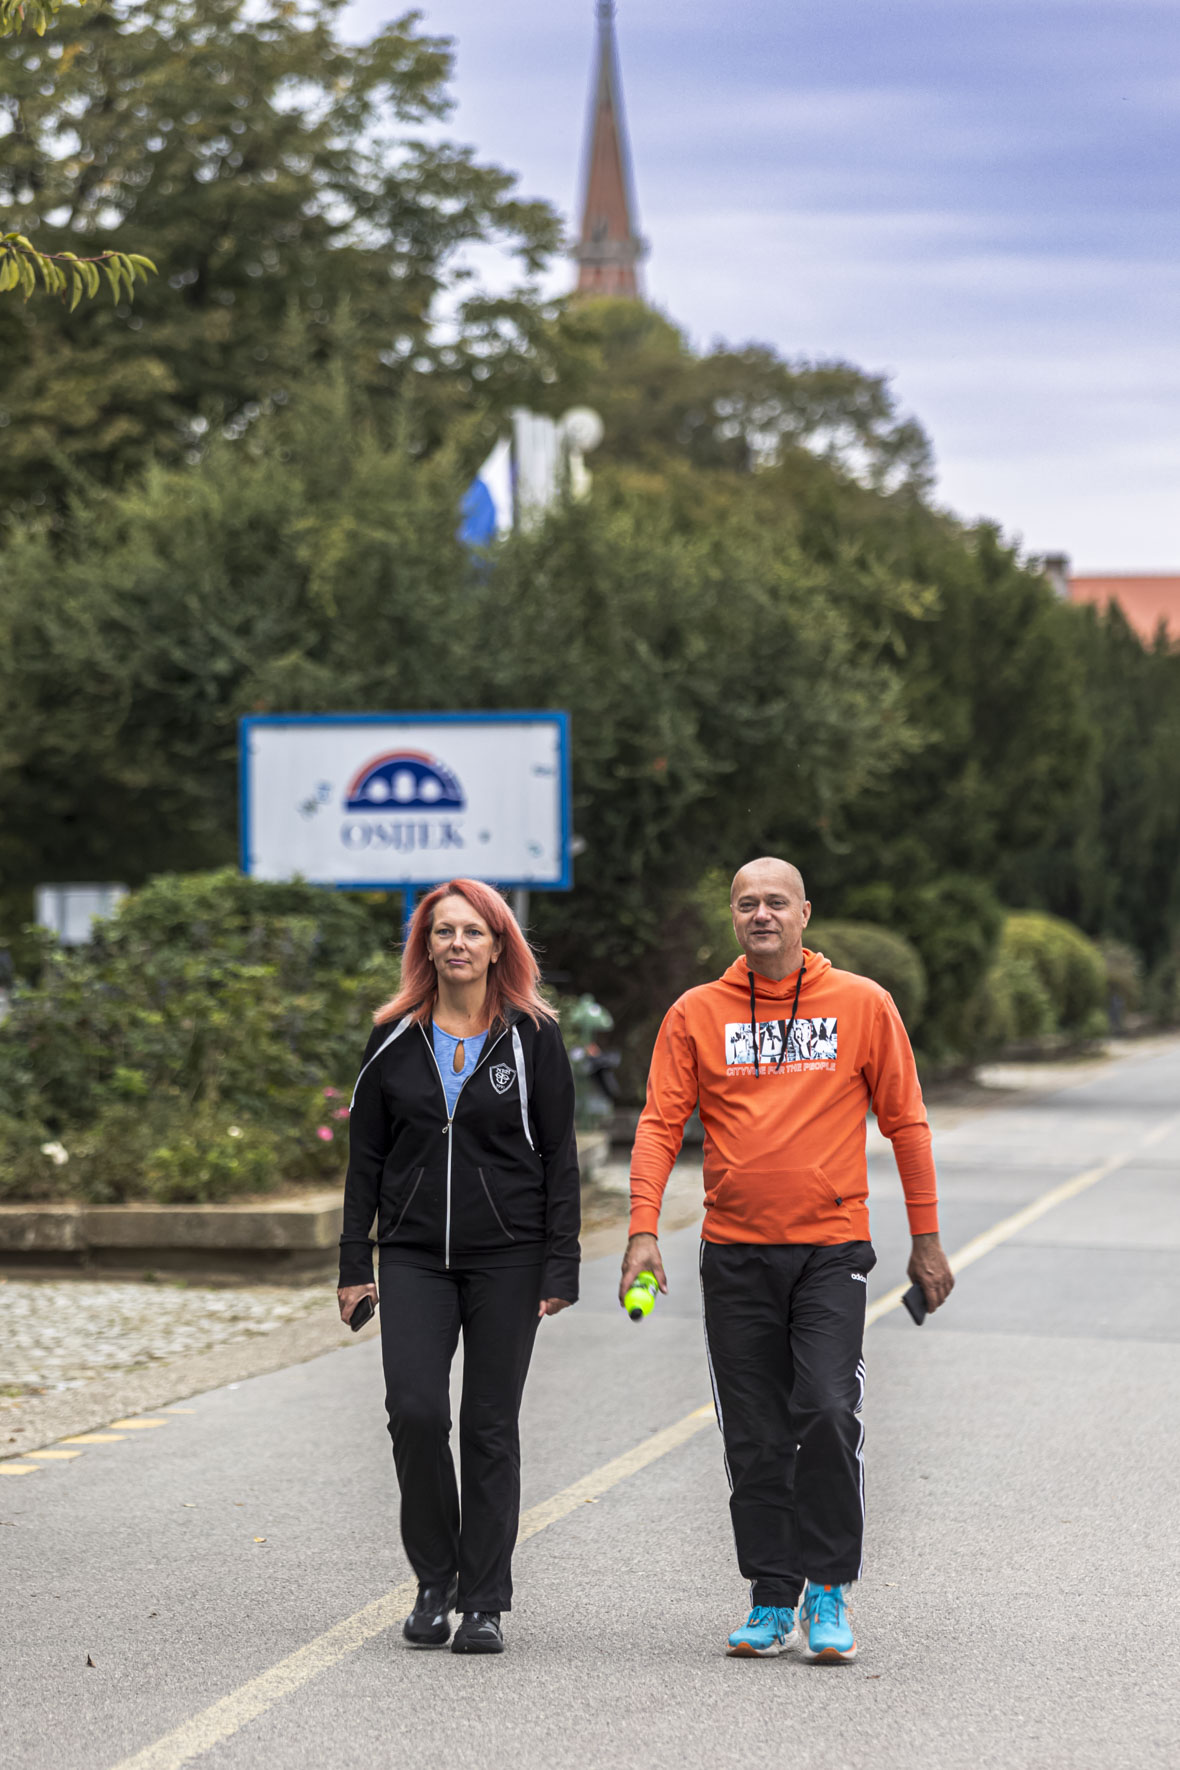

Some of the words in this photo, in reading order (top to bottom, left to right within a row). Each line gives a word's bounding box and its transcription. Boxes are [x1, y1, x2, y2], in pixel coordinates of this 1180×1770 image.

[340, 820, 465, 852] OSIJEK
[768, 1065, 785, 1075] FOR
[786, 1063, 802, 1073] THE
[803, 1062, 836, 1072] PEOPLE
